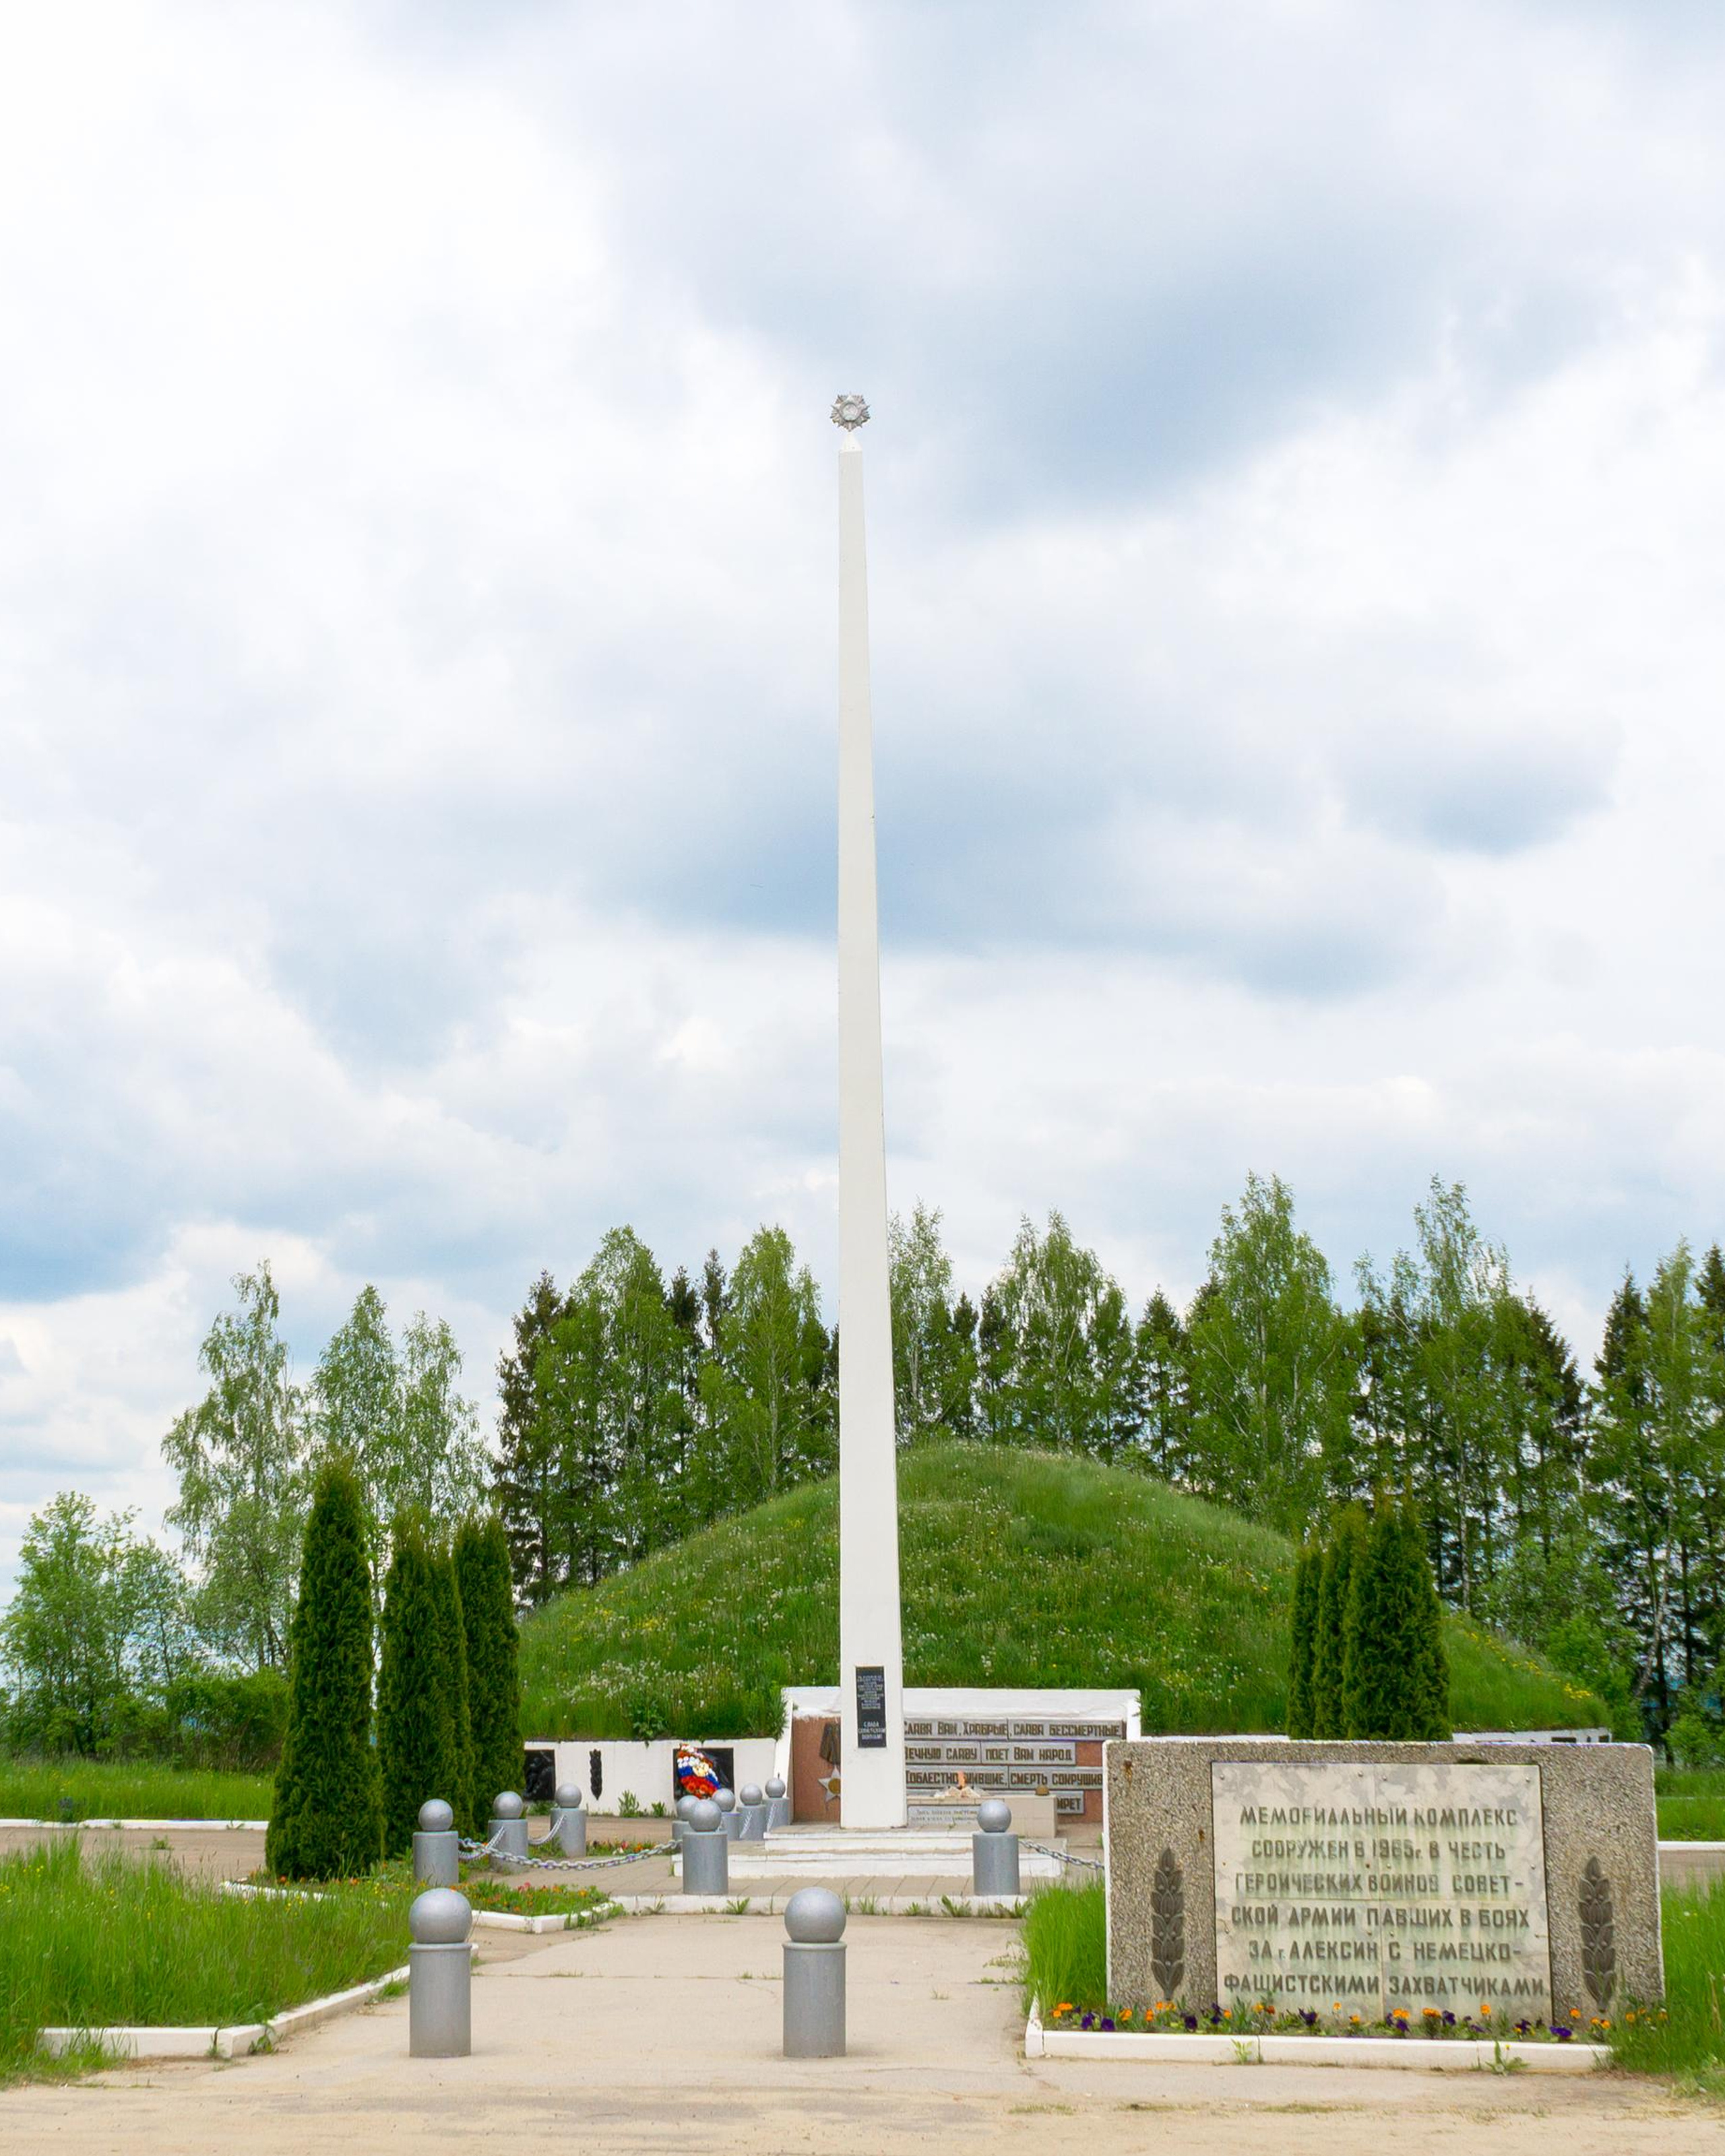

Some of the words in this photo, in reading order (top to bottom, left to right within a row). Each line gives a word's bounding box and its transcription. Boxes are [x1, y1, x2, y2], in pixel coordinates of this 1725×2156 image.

[1013, 1723, 1044, 1736] СЛАВА
[946, 1747, 976, 1761] СЛАВУ
[985, 1748, 1009, 1761] ПОЕТ
[1013, 1746, 1034, 1761] ВАМ
[1039, 1748, 1072, 1761] НАРОД
[1011, 1773, 1048, 1785] СМЕРТЬ
[1052, 1773, 1102, 1785] СОКРУШИВ
[1057, 1798, 1081, 1810] МРЕТ
[1414, 1808, 1517, 1827] КОМПЛЕКС
[1252, 1839, 1348, 1859] СООРУЖЕН
[1354, 1840, 1365, 1858] В
[1429, 1841, 1440, 1859] В
[1449, 1841, 1506, 1860] ЧЕСТЬ
[1235, 1872, 1363, 1893] ГЕРОИЧЕСКИХ
[1368, 1873, 1439, 1893] ВОИНОВ
[1231, 1904, 1279, 1926] СКОЙ
[1288, 1906, 1356, 1926] АРМИИ
[1367, 1907, 1453, 1928] ПАВШИХ
[1460, 1908, 1471, 1927] В
[1478, 1909, 1530, 1928] БОЯХ
[1249, 1940, 1273, 1959] ЗА
[1289, 1940, 1378, 1960] АЛЕКСИН
[1389, 1941, 1401, 1961] С
[1224, 1973, 1380, 1994] ФАШИСТСКИМИ
